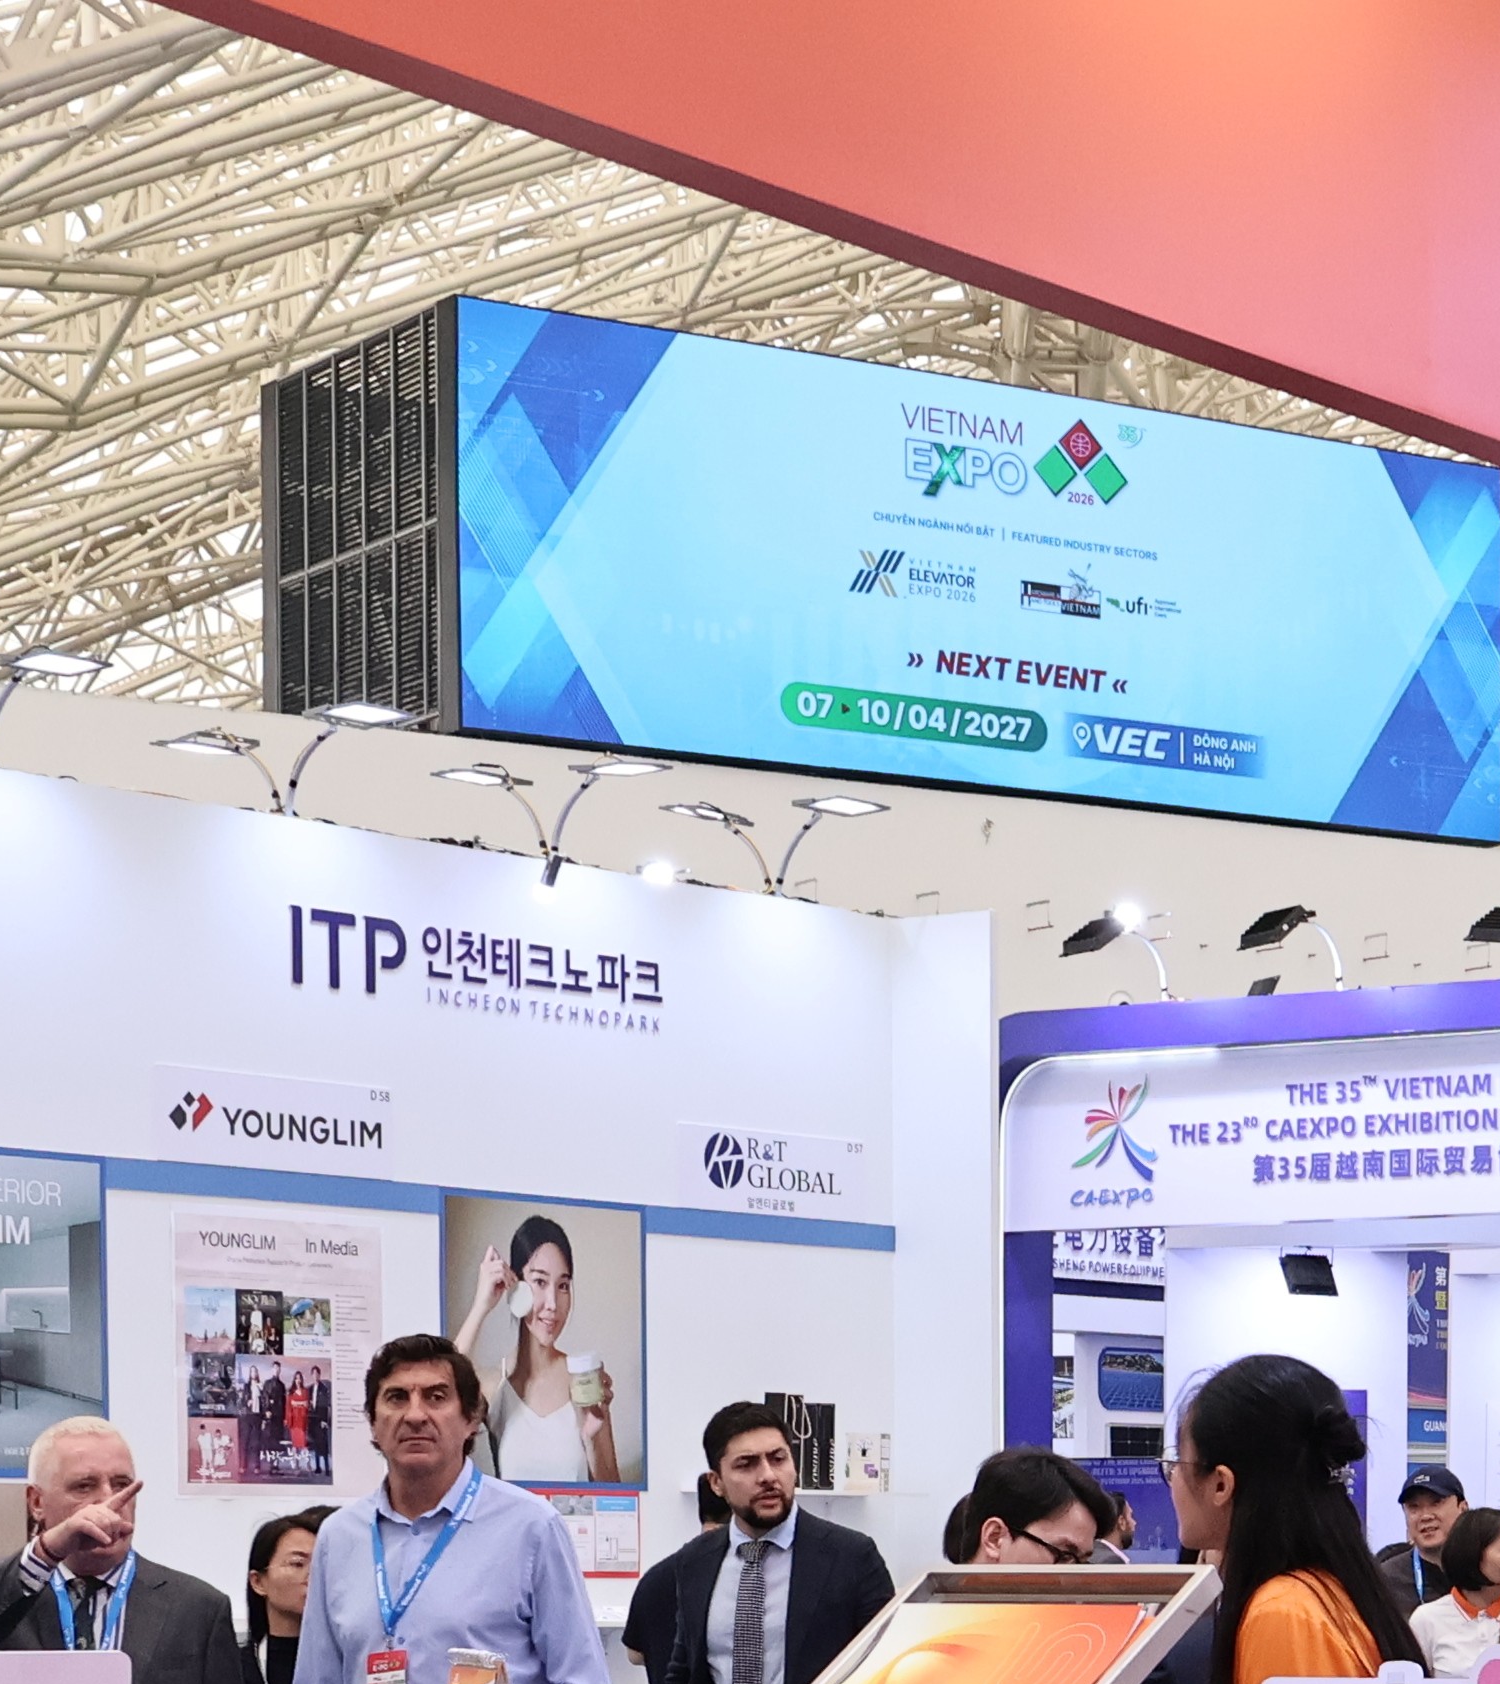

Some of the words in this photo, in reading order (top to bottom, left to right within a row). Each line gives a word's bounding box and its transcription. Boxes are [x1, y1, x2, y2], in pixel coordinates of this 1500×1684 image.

[900, 402, 1024, 446] VIETNAM
[904, 437, 1028, 497] EXPO
[1067, 491, 1095, 506] 2026
[1011, 530, 1061, 547] FEATURED
[1063, 538, 1112, 555] INDUSTRY
[1113, 545, 1159, 561] SECTORS
[908, 568, 976, 590] ELEVATOR
[908, 583, 941, 600] EXPO
[946, 587, 977, 603] 2026
[935, 649, 1013, 681] NEXT
[1016, 660, 1107, 694] EVENT
[796, 689, 834, 719] 07
[1092, 722, 1172, 760] VEC
[1192, 733, 1229, 752] ĐÔNG
[1229, 738, 1257, 754] ANH
[1192, 751, 1214, 768] HÀ
[1216, 753, 1236, 771] NỘI
[289, 904, 407, 995] ITP
[421, 925, 665, 1004] 인천테크노파크
[426, 986, 521, 1016] INCHEON
[530, 1000, 661, 1034] TECHNOPARK
[1285, 1081, 1329, 1107] THE
[1384, 1070, 1494, 1103] VIETNAM
[221, 1106, 383, 1150] YOUNGLIM
[1168, 1120, 1211, 1146] THE
[1264, 1113, 1358, 1142] CAEXPO
[1363, 1106, 1500, 1138] EXHIBITION
[746, 1136, 788, 1163] R&T
[746, 1163, 843, 1196] GLOBAL
[198, 1229, 277, 1251] YOUNGLIM
[320, 1238, 360, 1257] Media
